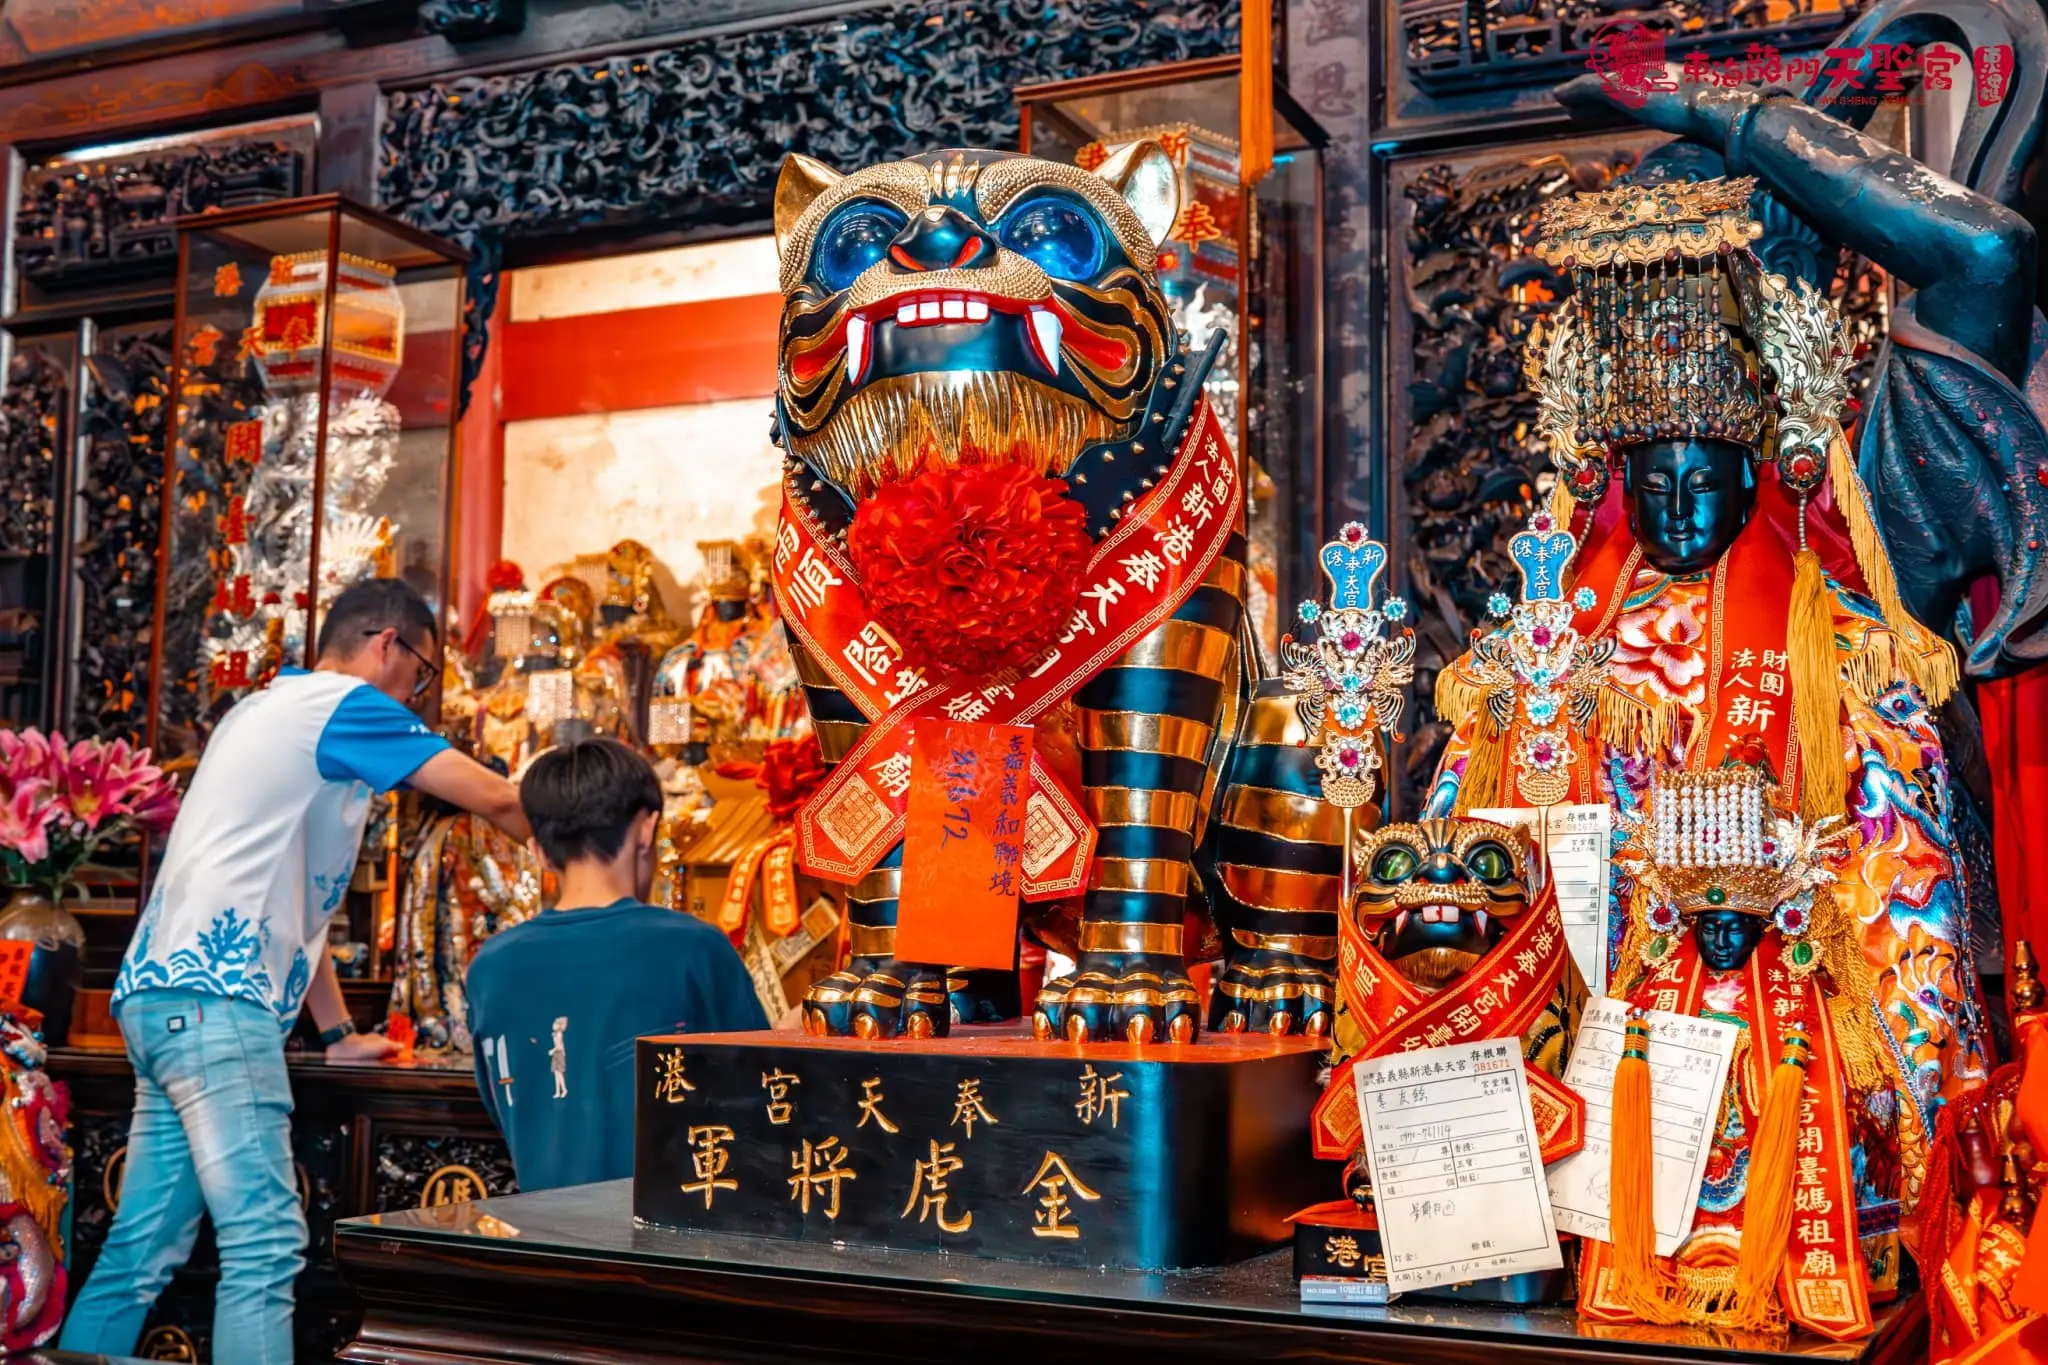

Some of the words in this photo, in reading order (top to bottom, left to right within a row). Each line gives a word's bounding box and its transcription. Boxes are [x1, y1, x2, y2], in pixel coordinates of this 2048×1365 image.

[1375, 1058, 1466, 1085] 嘉義縣新港奉天宮
[1470, 1048, 1508, 1062] 存根聯
